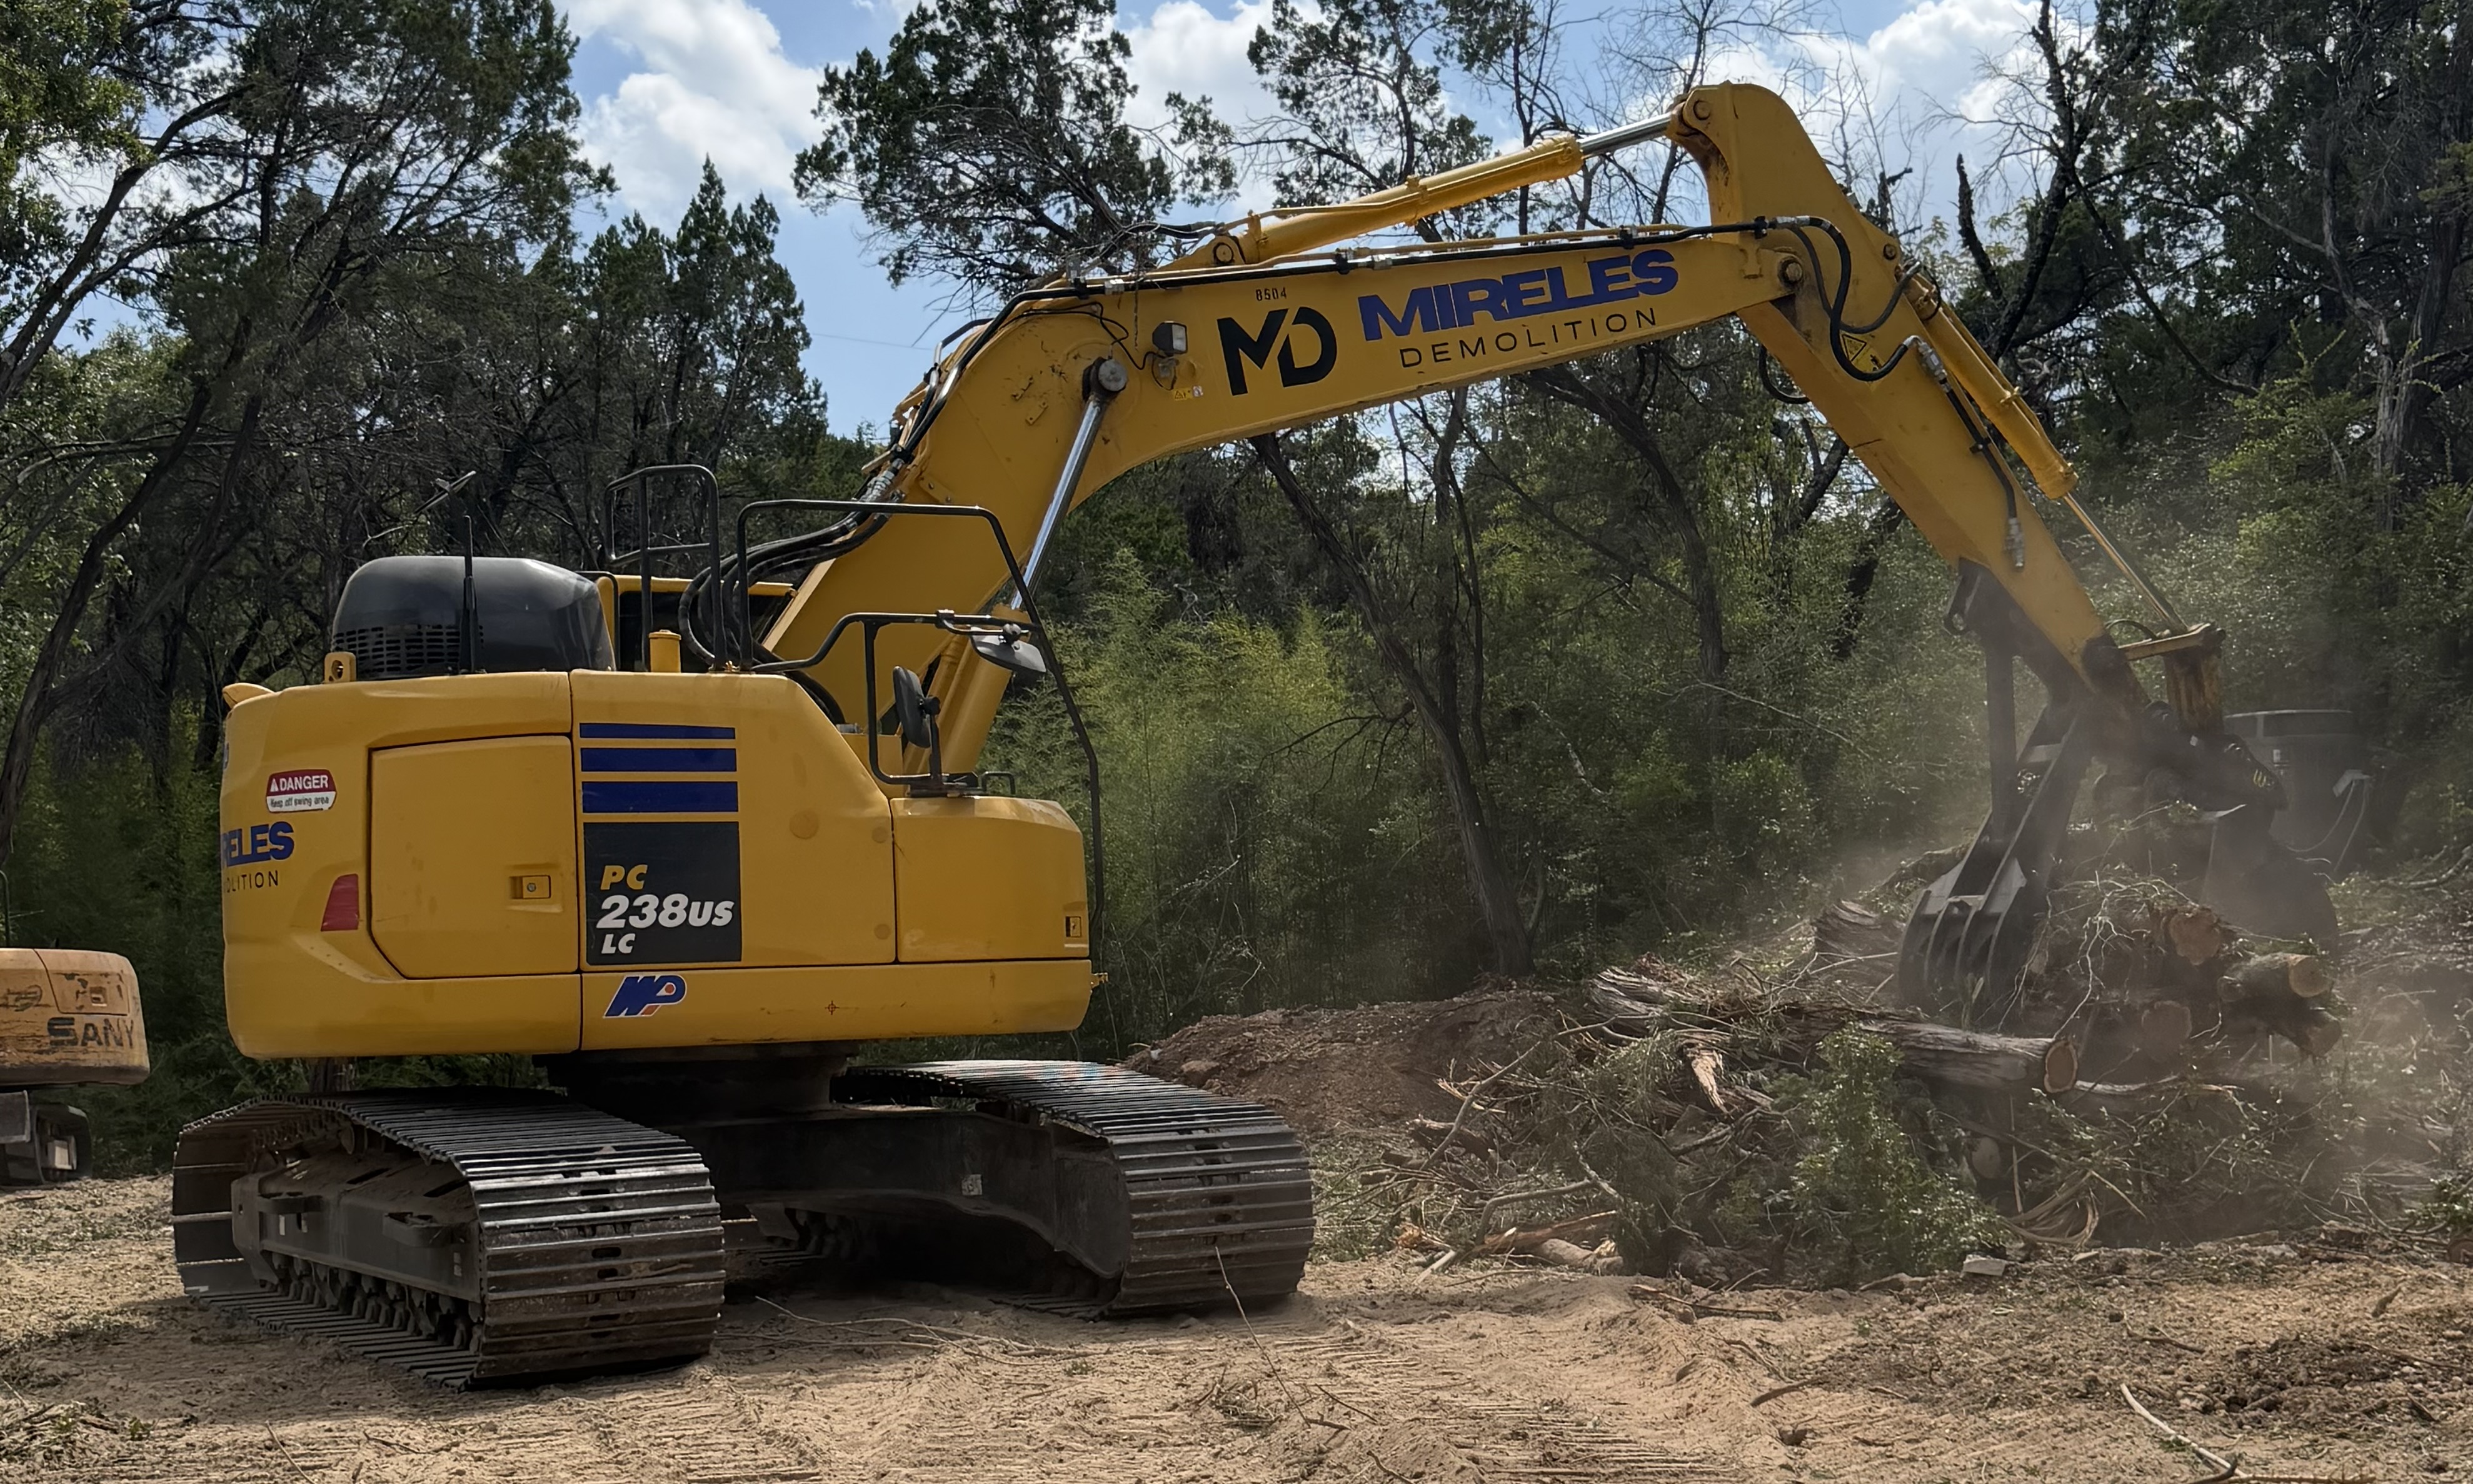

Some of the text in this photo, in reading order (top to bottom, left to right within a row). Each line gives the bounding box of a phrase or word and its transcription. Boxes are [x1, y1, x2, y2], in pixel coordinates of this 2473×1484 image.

[1255, 287, 1287, 301] 8504
[1357, 249, 1679, 341] MIRELES
[1216, 306, 1338, 396] MD
[1399, 307, 1657, 369] DEMOLITION
[279, 775, 329, 791] DANGER
[314, 796, 329, 805] area
[600, 864, 648, 891] PC
[596, 893, 735, 930] 238US
[601, 933, 636, 955] LC
[47, 1016, 134, 1050] SANY
